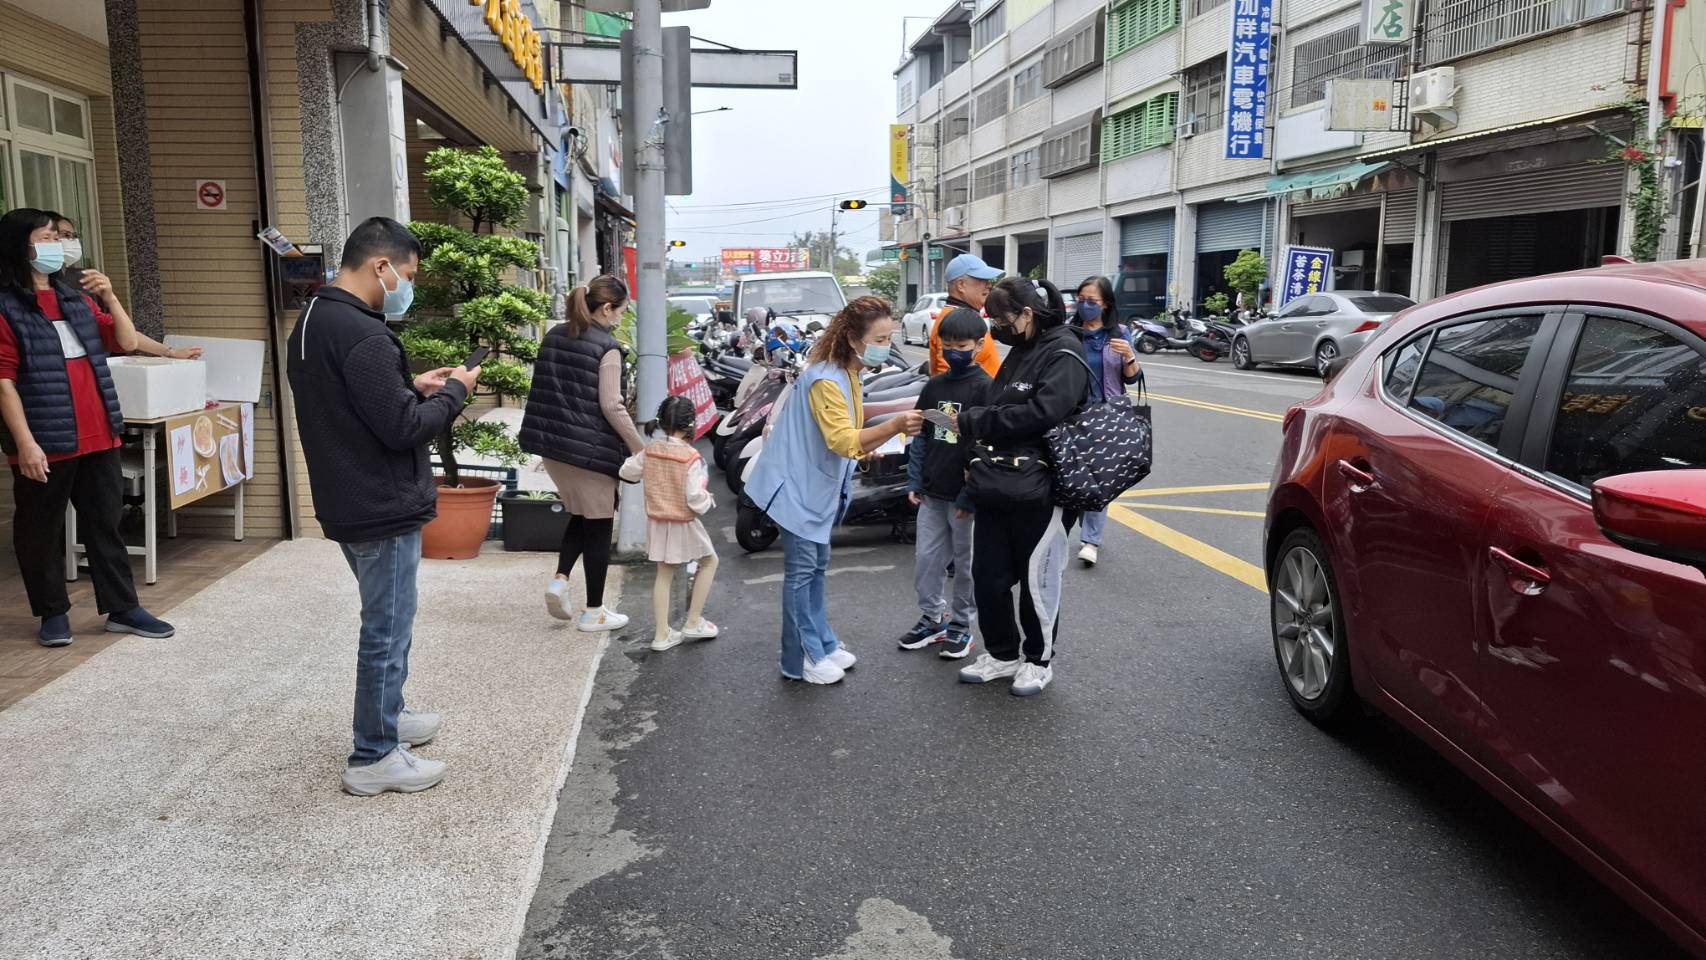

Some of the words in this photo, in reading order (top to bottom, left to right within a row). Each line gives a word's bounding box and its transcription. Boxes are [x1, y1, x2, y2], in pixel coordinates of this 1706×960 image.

[1373, 0, 1404, 38] 店
[1229, 0, 1259, 155] 加祥汽車電機行
